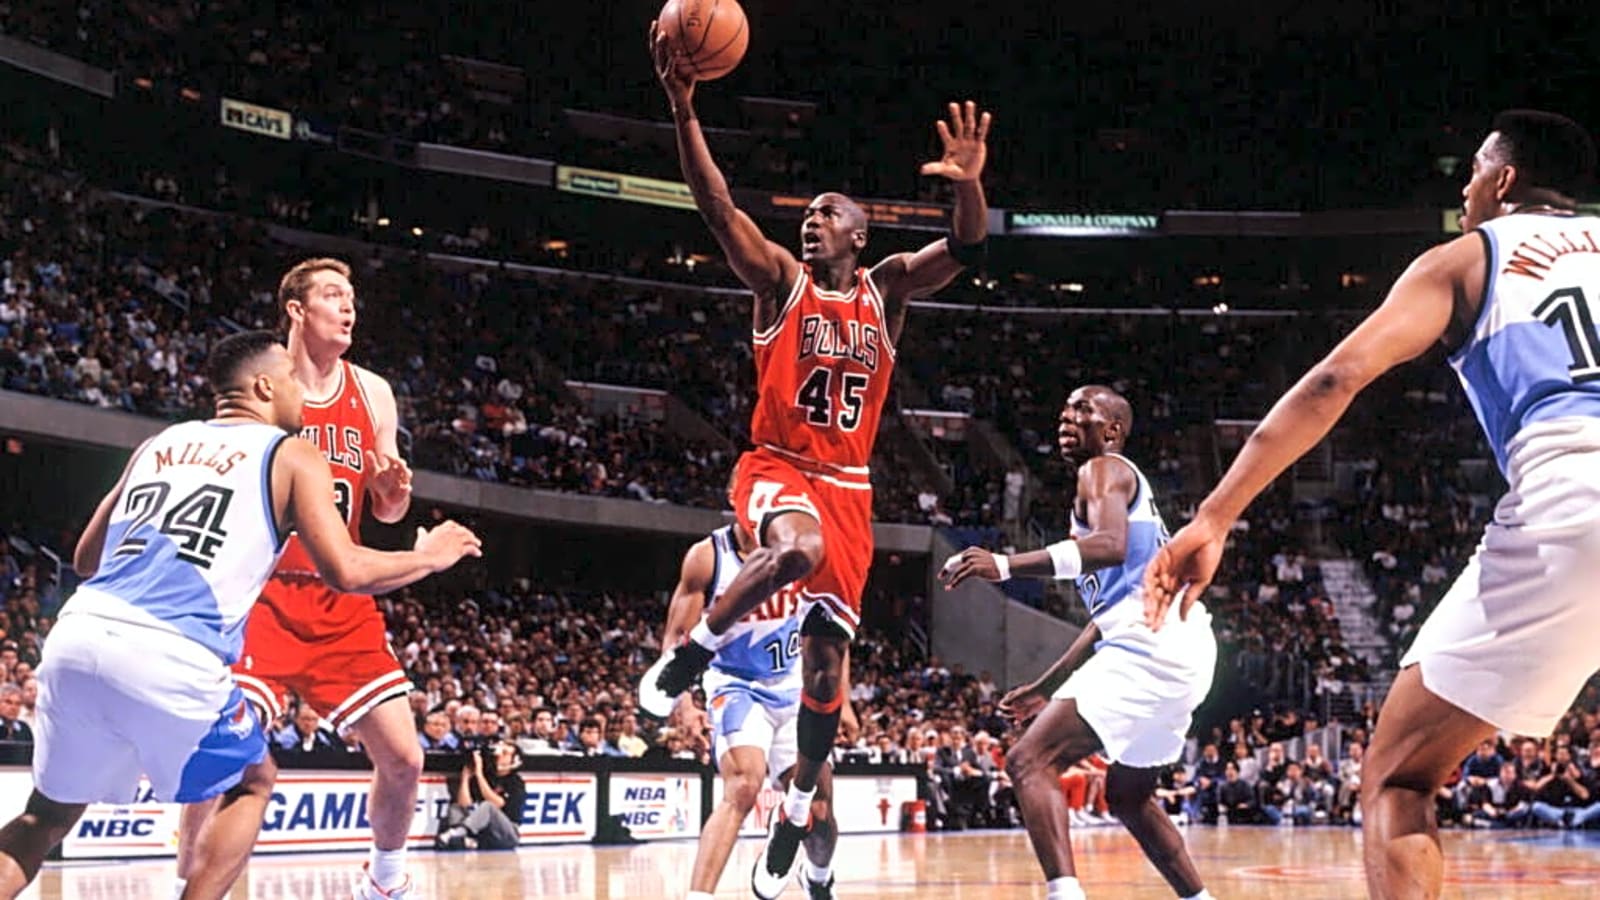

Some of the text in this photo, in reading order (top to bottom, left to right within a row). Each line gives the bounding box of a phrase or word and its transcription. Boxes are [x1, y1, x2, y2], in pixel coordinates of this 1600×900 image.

[1095, 214, 1158, 228] COMPANY
[799, 314, 879, 373] BULLS
[1532, 286, 1600, 384] 1
[795, 366, 869, 432] 45
[154, 443, 246, 476] MILLS
[113, 481, 234, 570] 24
[519, 792, 586, 825] EEK
[624, 787, 666, 801] NBA
[78, 818, 155, 838] NBC
[621, 811, 661, 826] NBC
